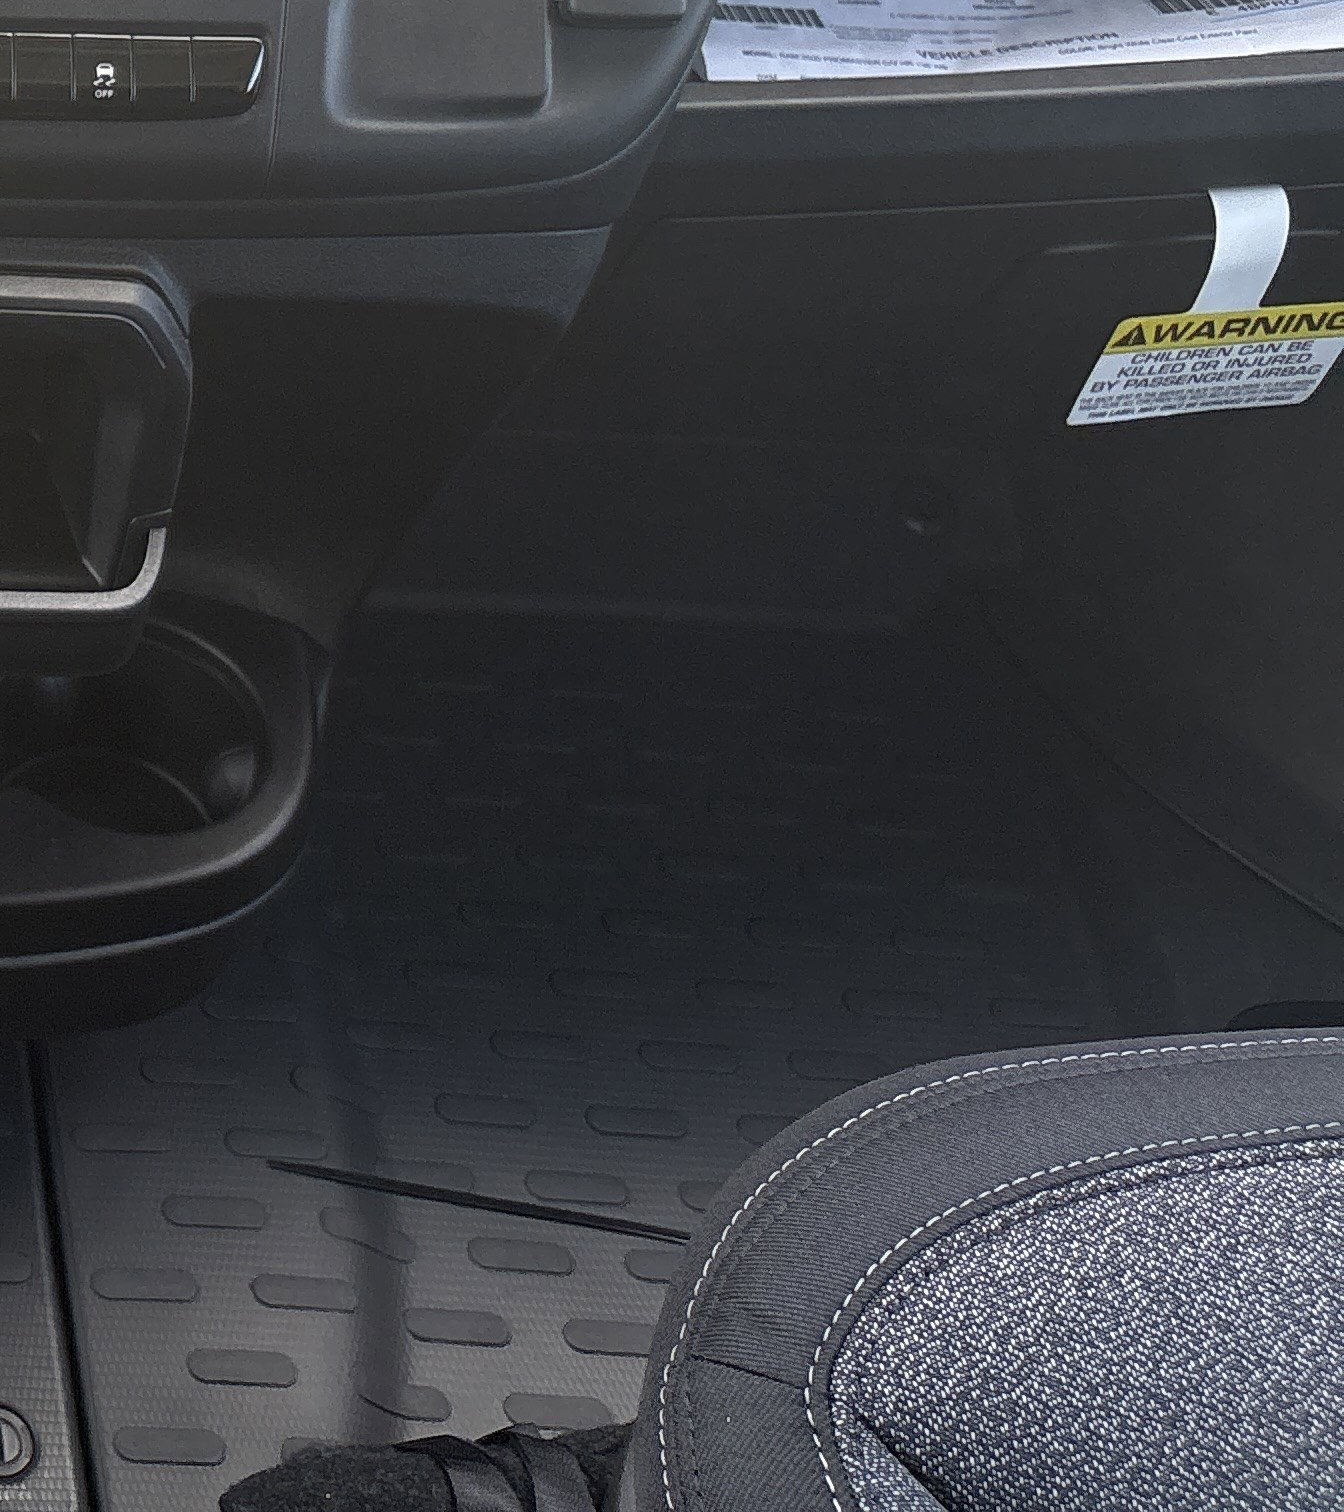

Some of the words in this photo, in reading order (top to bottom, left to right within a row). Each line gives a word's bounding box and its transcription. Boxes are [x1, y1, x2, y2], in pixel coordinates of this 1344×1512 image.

[94, 90, 114, 100] OFF
[1152, 311, 1344, 343] WARNING
[1131, 346, 1233, 365] CHILDREN
[1238, 342, 1281, 354] CAN
[1286, 340, 1315, 352] BE
[1116, 362, 1186, 378] KILLED
[1190, 360, 1220, 373] OR
[1225, 353, 1312, 368] INJURED
[1090, 380, 1120, 393] BY
[1123, 369, 1243, 390] PASSENGER
[1246, 364, 1323, 379] AIRBAG
